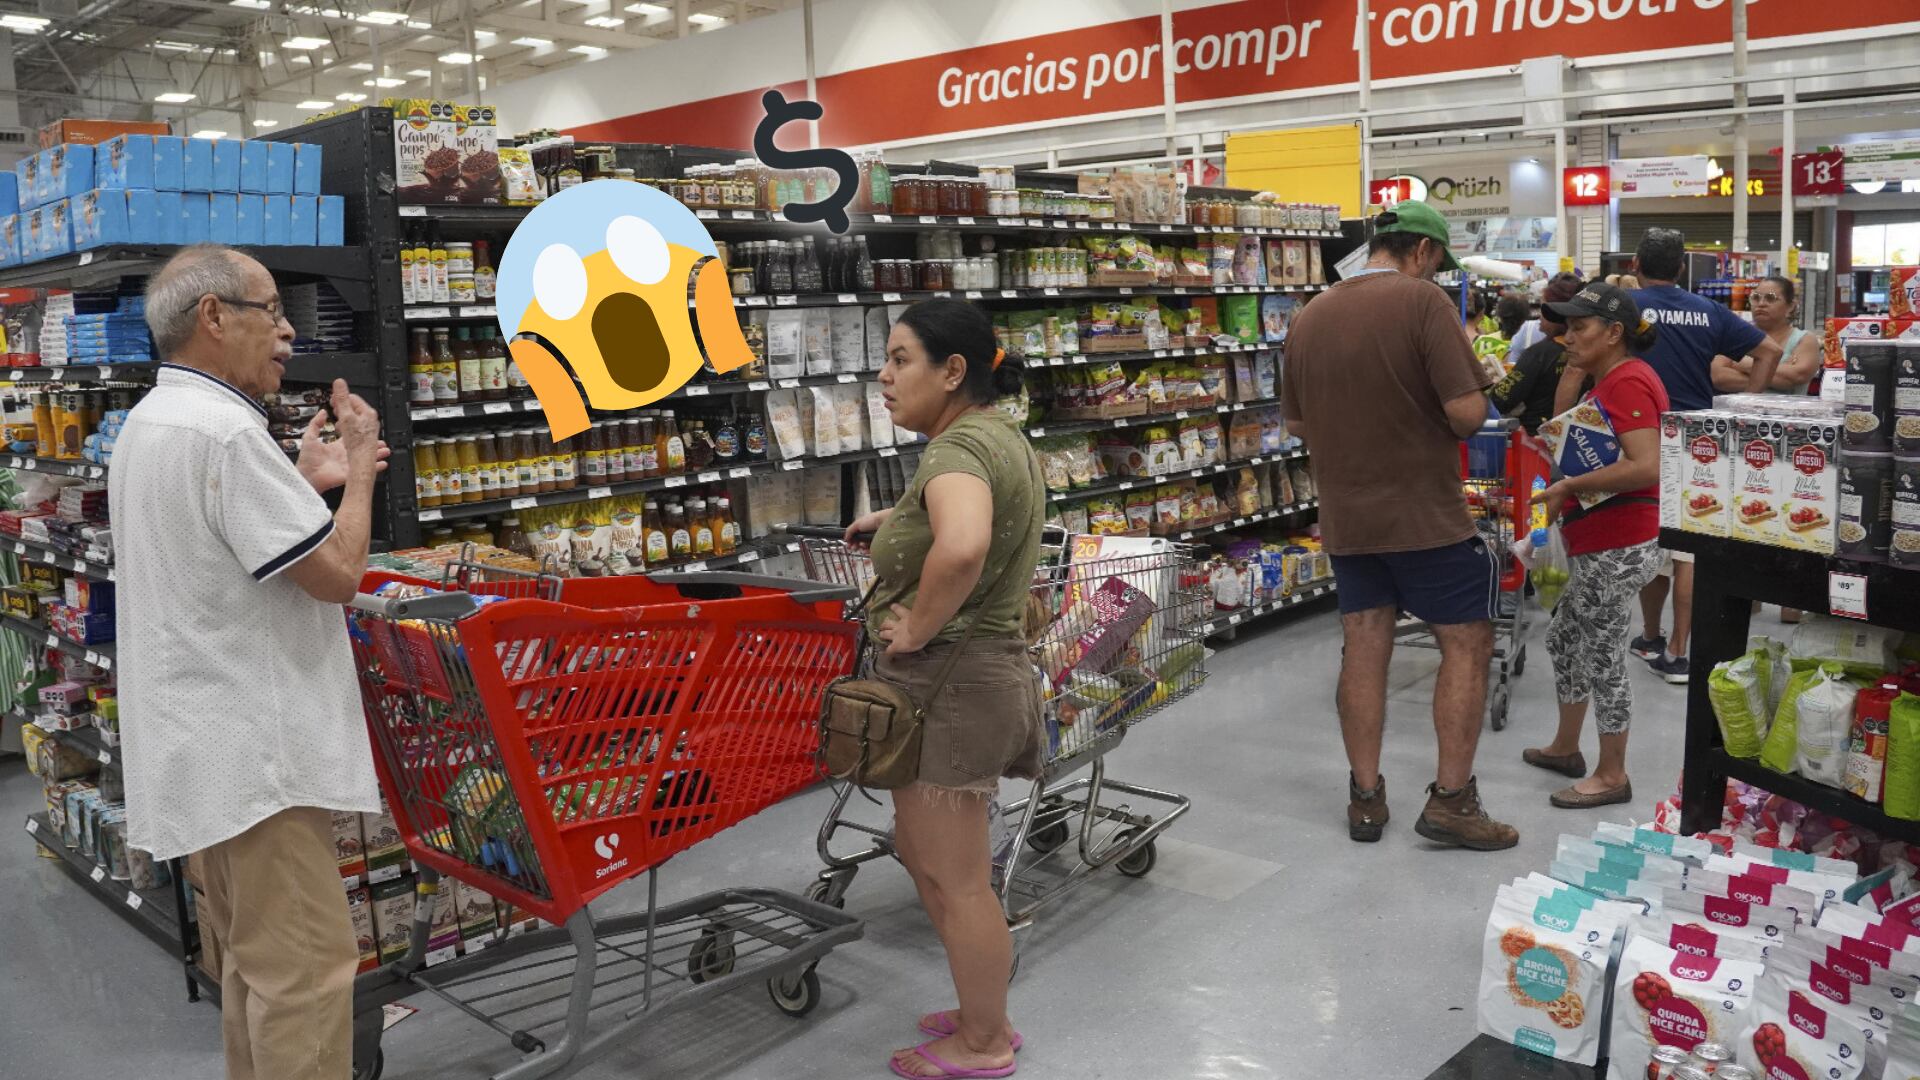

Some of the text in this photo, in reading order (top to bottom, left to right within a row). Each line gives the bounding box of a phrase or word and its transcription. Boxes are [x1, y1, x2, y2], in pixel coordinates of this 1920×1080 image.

[937, 53, 1078, 108] Gracias
[1083, 42, 1160, 99] por
[1383, 1, 1478, 47] con
[1491, 0, 1761, 33] noso
[398, 123, 440, 146] Campo
[400, 144, 424, 158] pops
[1803, 160, 1833, 185] 13
[1378, 186, 1398, 204] 11
[1430, 175, 1501, 204] Qrüzh
[1573, 173, 1599, 197] 12
[1658, 309, 1710, 327] YAMAHA
[1746, 450, 1772, 462] GRISSOL
[1795, 455, 1823, 468] GRISSOL
[612, 528, 637, 542] ARINA
[1075, 542, 1097, 559] 20
[596, 858, 628, 879] Soriana
[1516, 966, 1568, 987] RICE CAKE
[1524, 959, 1562, 976] BROWN
[1649, 1015, 1707, 1039] RICE CAKE
[1657, 1008, 1700, 1028] QUINOA
